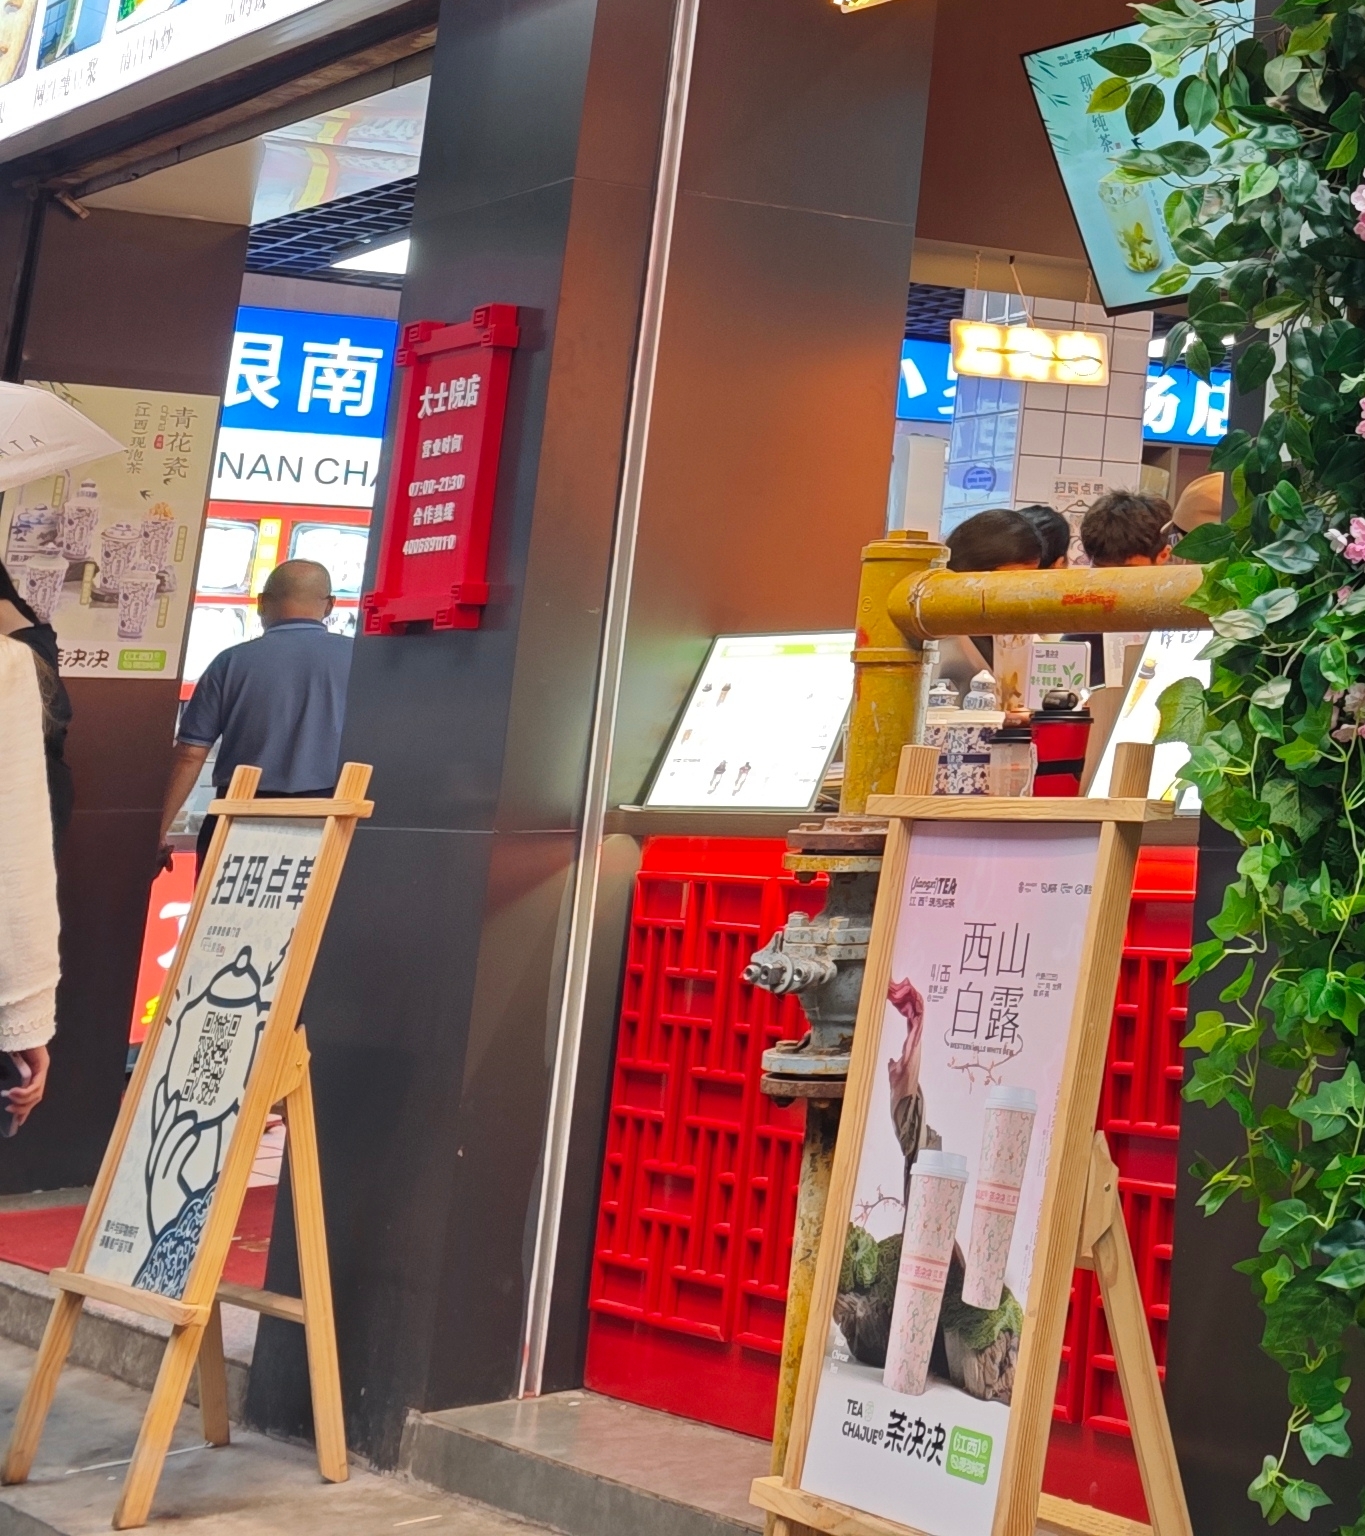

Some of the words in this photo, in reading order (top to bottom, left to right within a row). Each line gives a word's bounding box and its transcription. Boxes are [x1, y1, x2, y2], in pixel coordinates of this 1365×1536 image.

[417, 373, 482, 420] 大士院店
[162, 406, 199, 479] 青花瓷
[217, 451, 304, 483] NAN
[421, 434, 465, 459] 营业时间
[210, 853, 317, 911] 扫码点单
[959, 921, 1031, 979] 西山
[951, 981, 1024, 1044] 白露
[847, 1398, 864, 1418] TEA
[884, 1409, 947, 1467] 茶决决
